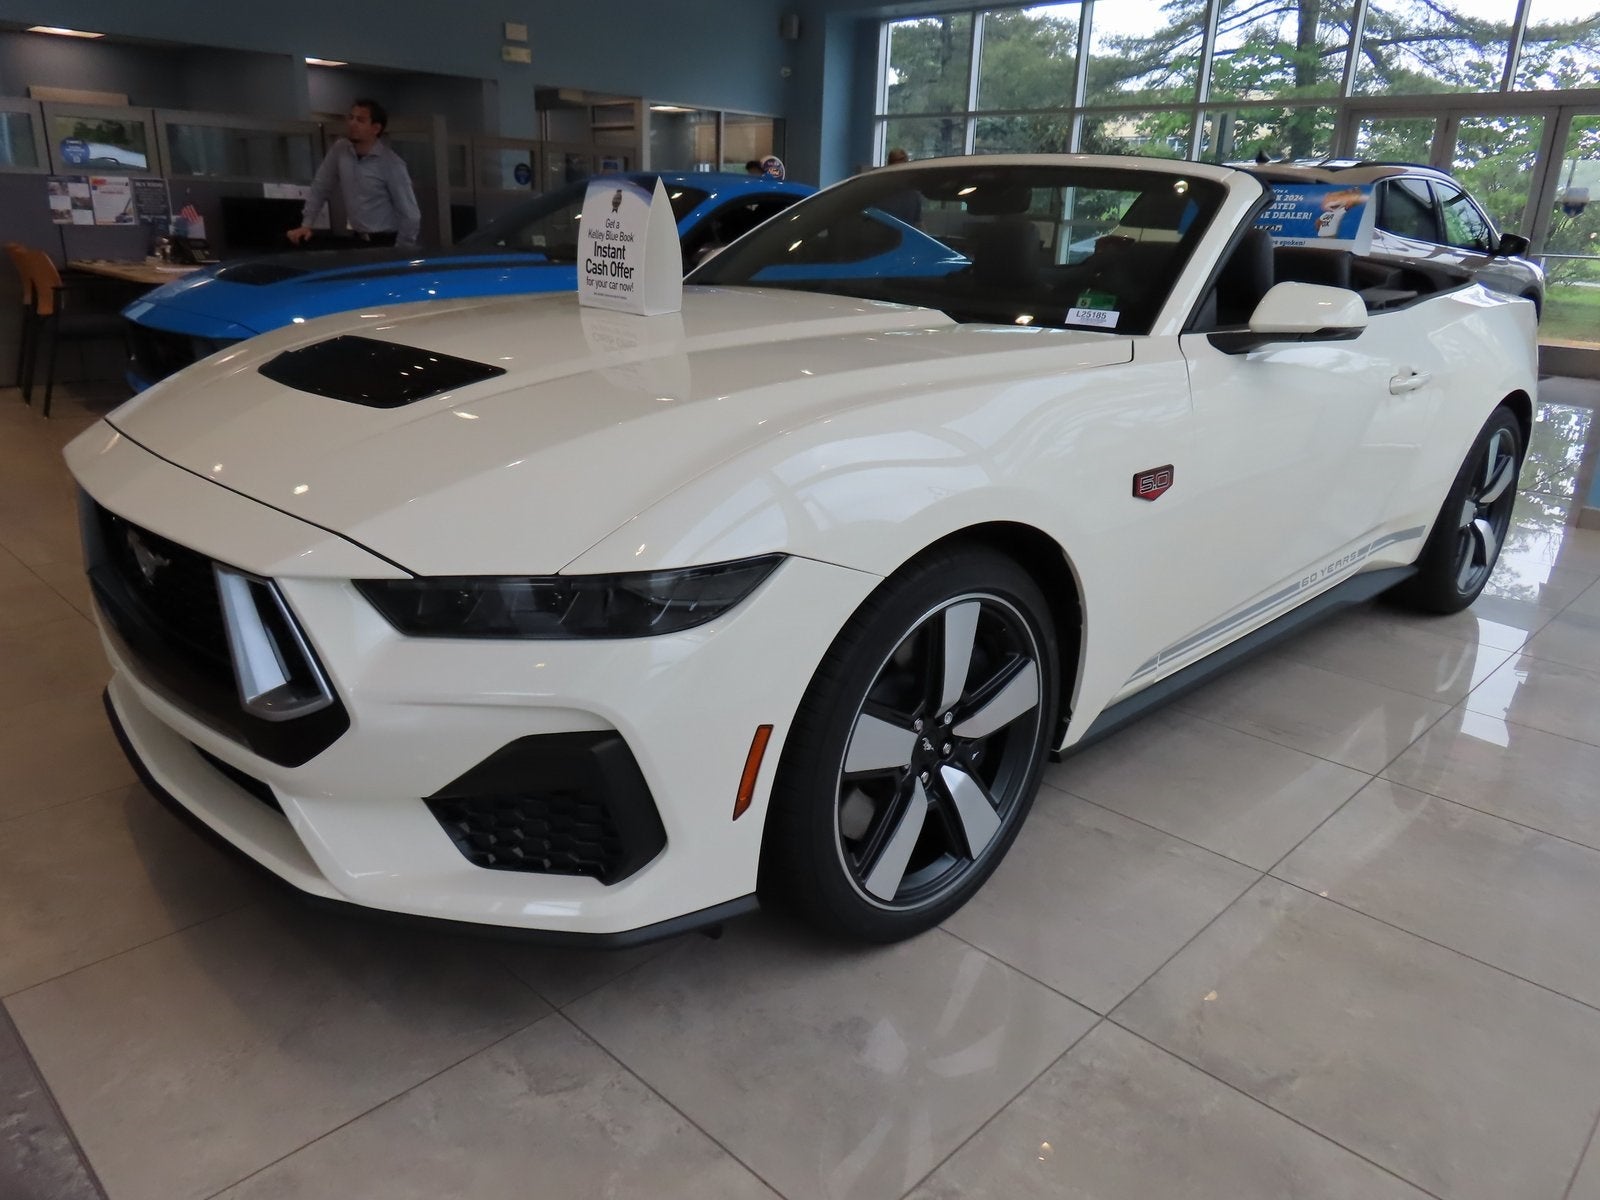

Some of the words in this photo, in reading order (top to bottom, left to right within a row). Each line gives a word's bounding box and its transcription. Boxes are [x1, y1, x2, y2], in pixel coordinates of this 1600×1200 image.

[1269, 202, 1296, 210] ATED
[1272, 212, 1312, 220] DEALER!
[605, 218, 615, 229] Get
[616, 221, 620, 229] a
[588, 228, 604, 241] Kelley
[606, 230, 619, 241] Blue
[620, 231, 634, 242] Book
[594, 241, 626, 260] Instant
[586, 258, 608, 275] Cash
[610, 261, 634, 279] Offer
[595, 279, 608, 289] your
[609, 282, 618, 290] car
[620, 282, 634, 292] now!
[1076, 310, 1107, 319] L25185
[1140, 470, 1170, 494] 5.0
[1302, 573, 1317, 587] 60
[1320, 552, 1357, 576] YEARS
